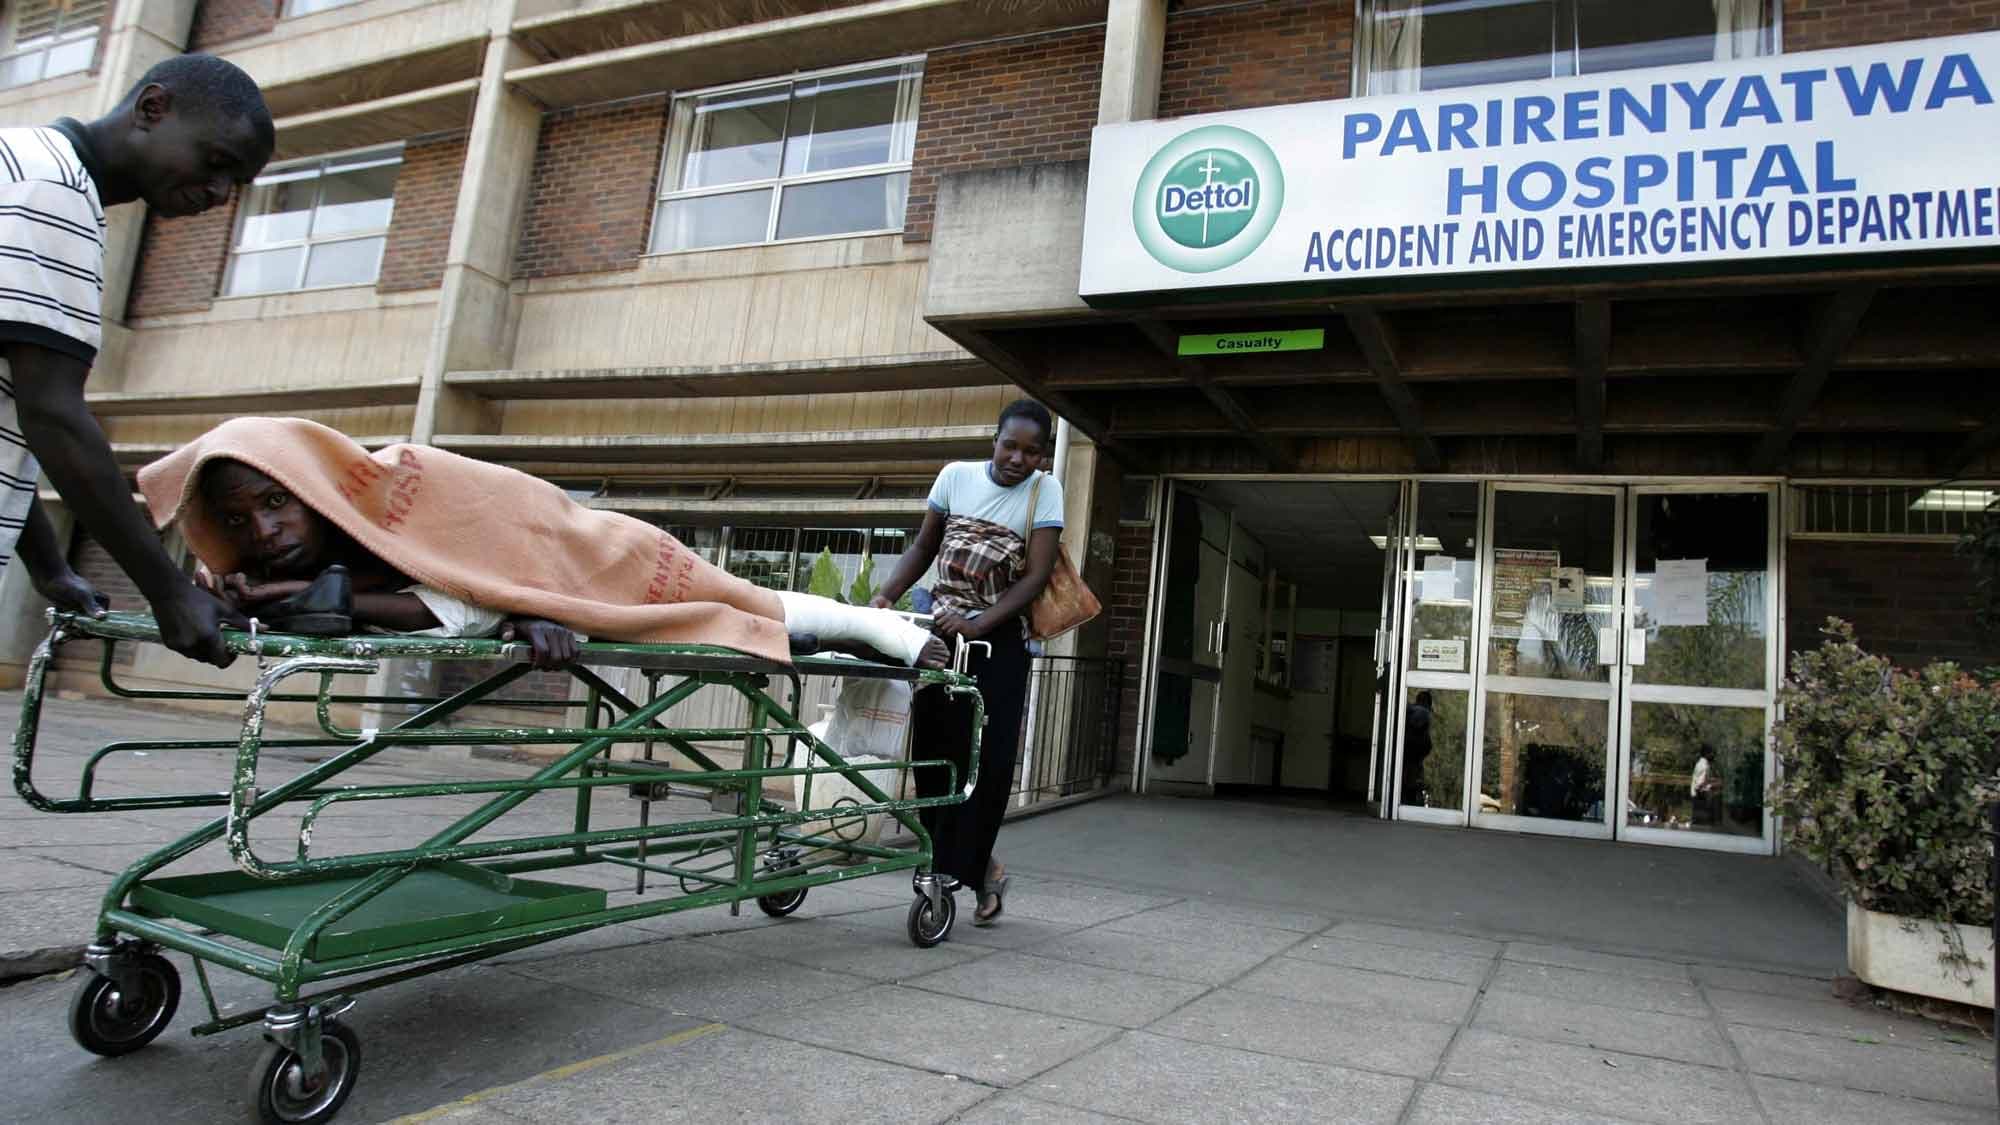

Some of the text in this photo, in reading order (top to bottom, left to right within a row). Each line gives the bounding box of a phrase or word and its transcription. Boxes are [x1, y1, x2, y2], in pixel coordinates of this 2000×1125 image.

[1344, 53, 1995, 160] PARIRENYATWA
[1164, 180, 1251, 213] Dettol
[1446, 140, 1857, 216] HOSPITAL
[1303, 187, 2000, 274] ACCIDENT AND EMERGENCY DEPARTME
[1216, 336, 1282, 350] Casualty
